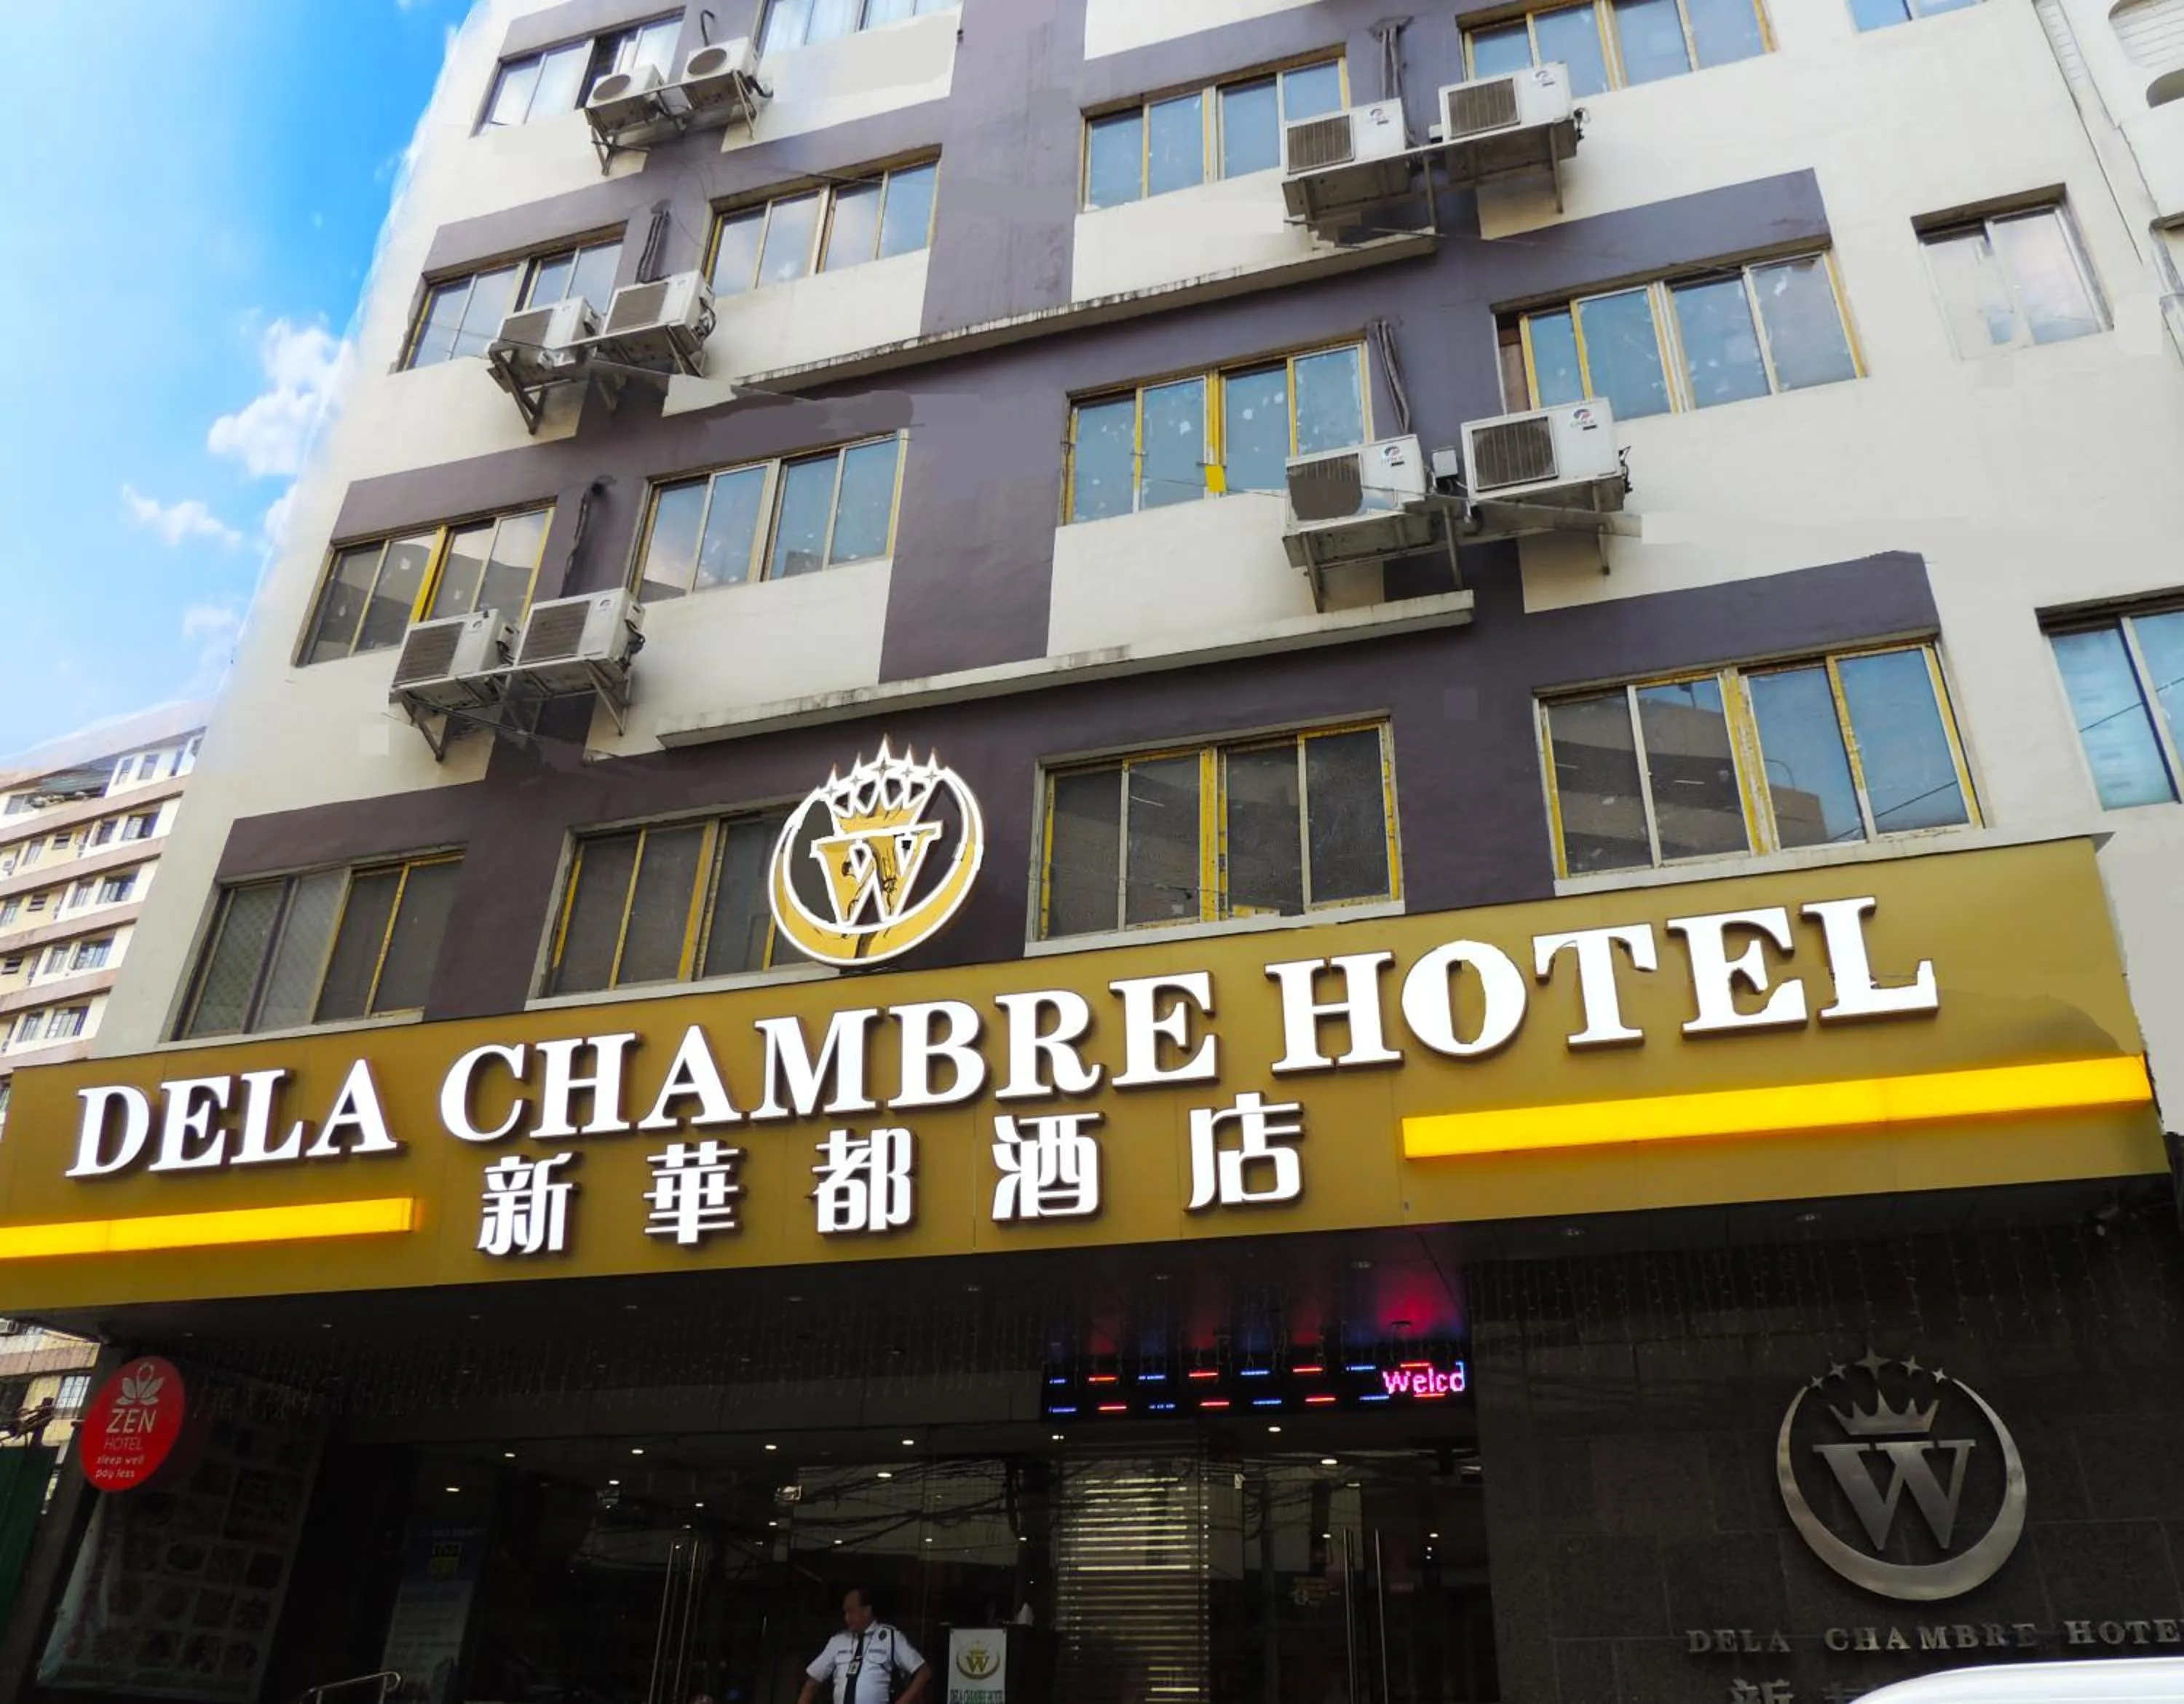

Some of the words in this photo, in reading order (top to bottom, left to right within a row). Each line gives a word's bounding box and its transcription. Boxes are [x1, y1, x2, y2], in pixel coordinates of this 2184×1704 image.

[65, 1057, 401, 1180] DELA
[440, 971, 1220, 1144] CHAMBRE
[1265, 896, 1939, 1074] HOTEL
[477, 1092, 1305, 1258] 新華都酒店
[106, 1408, 157, 1434] ZEN
[103, 1437, 143, 1451] HOTEL
[1686, 1628, 1792, 1653] DELA
[1823, 1623, 2038, 1652] CHAMBRE
[2064, 1618, 2184, 1645] HOTE
